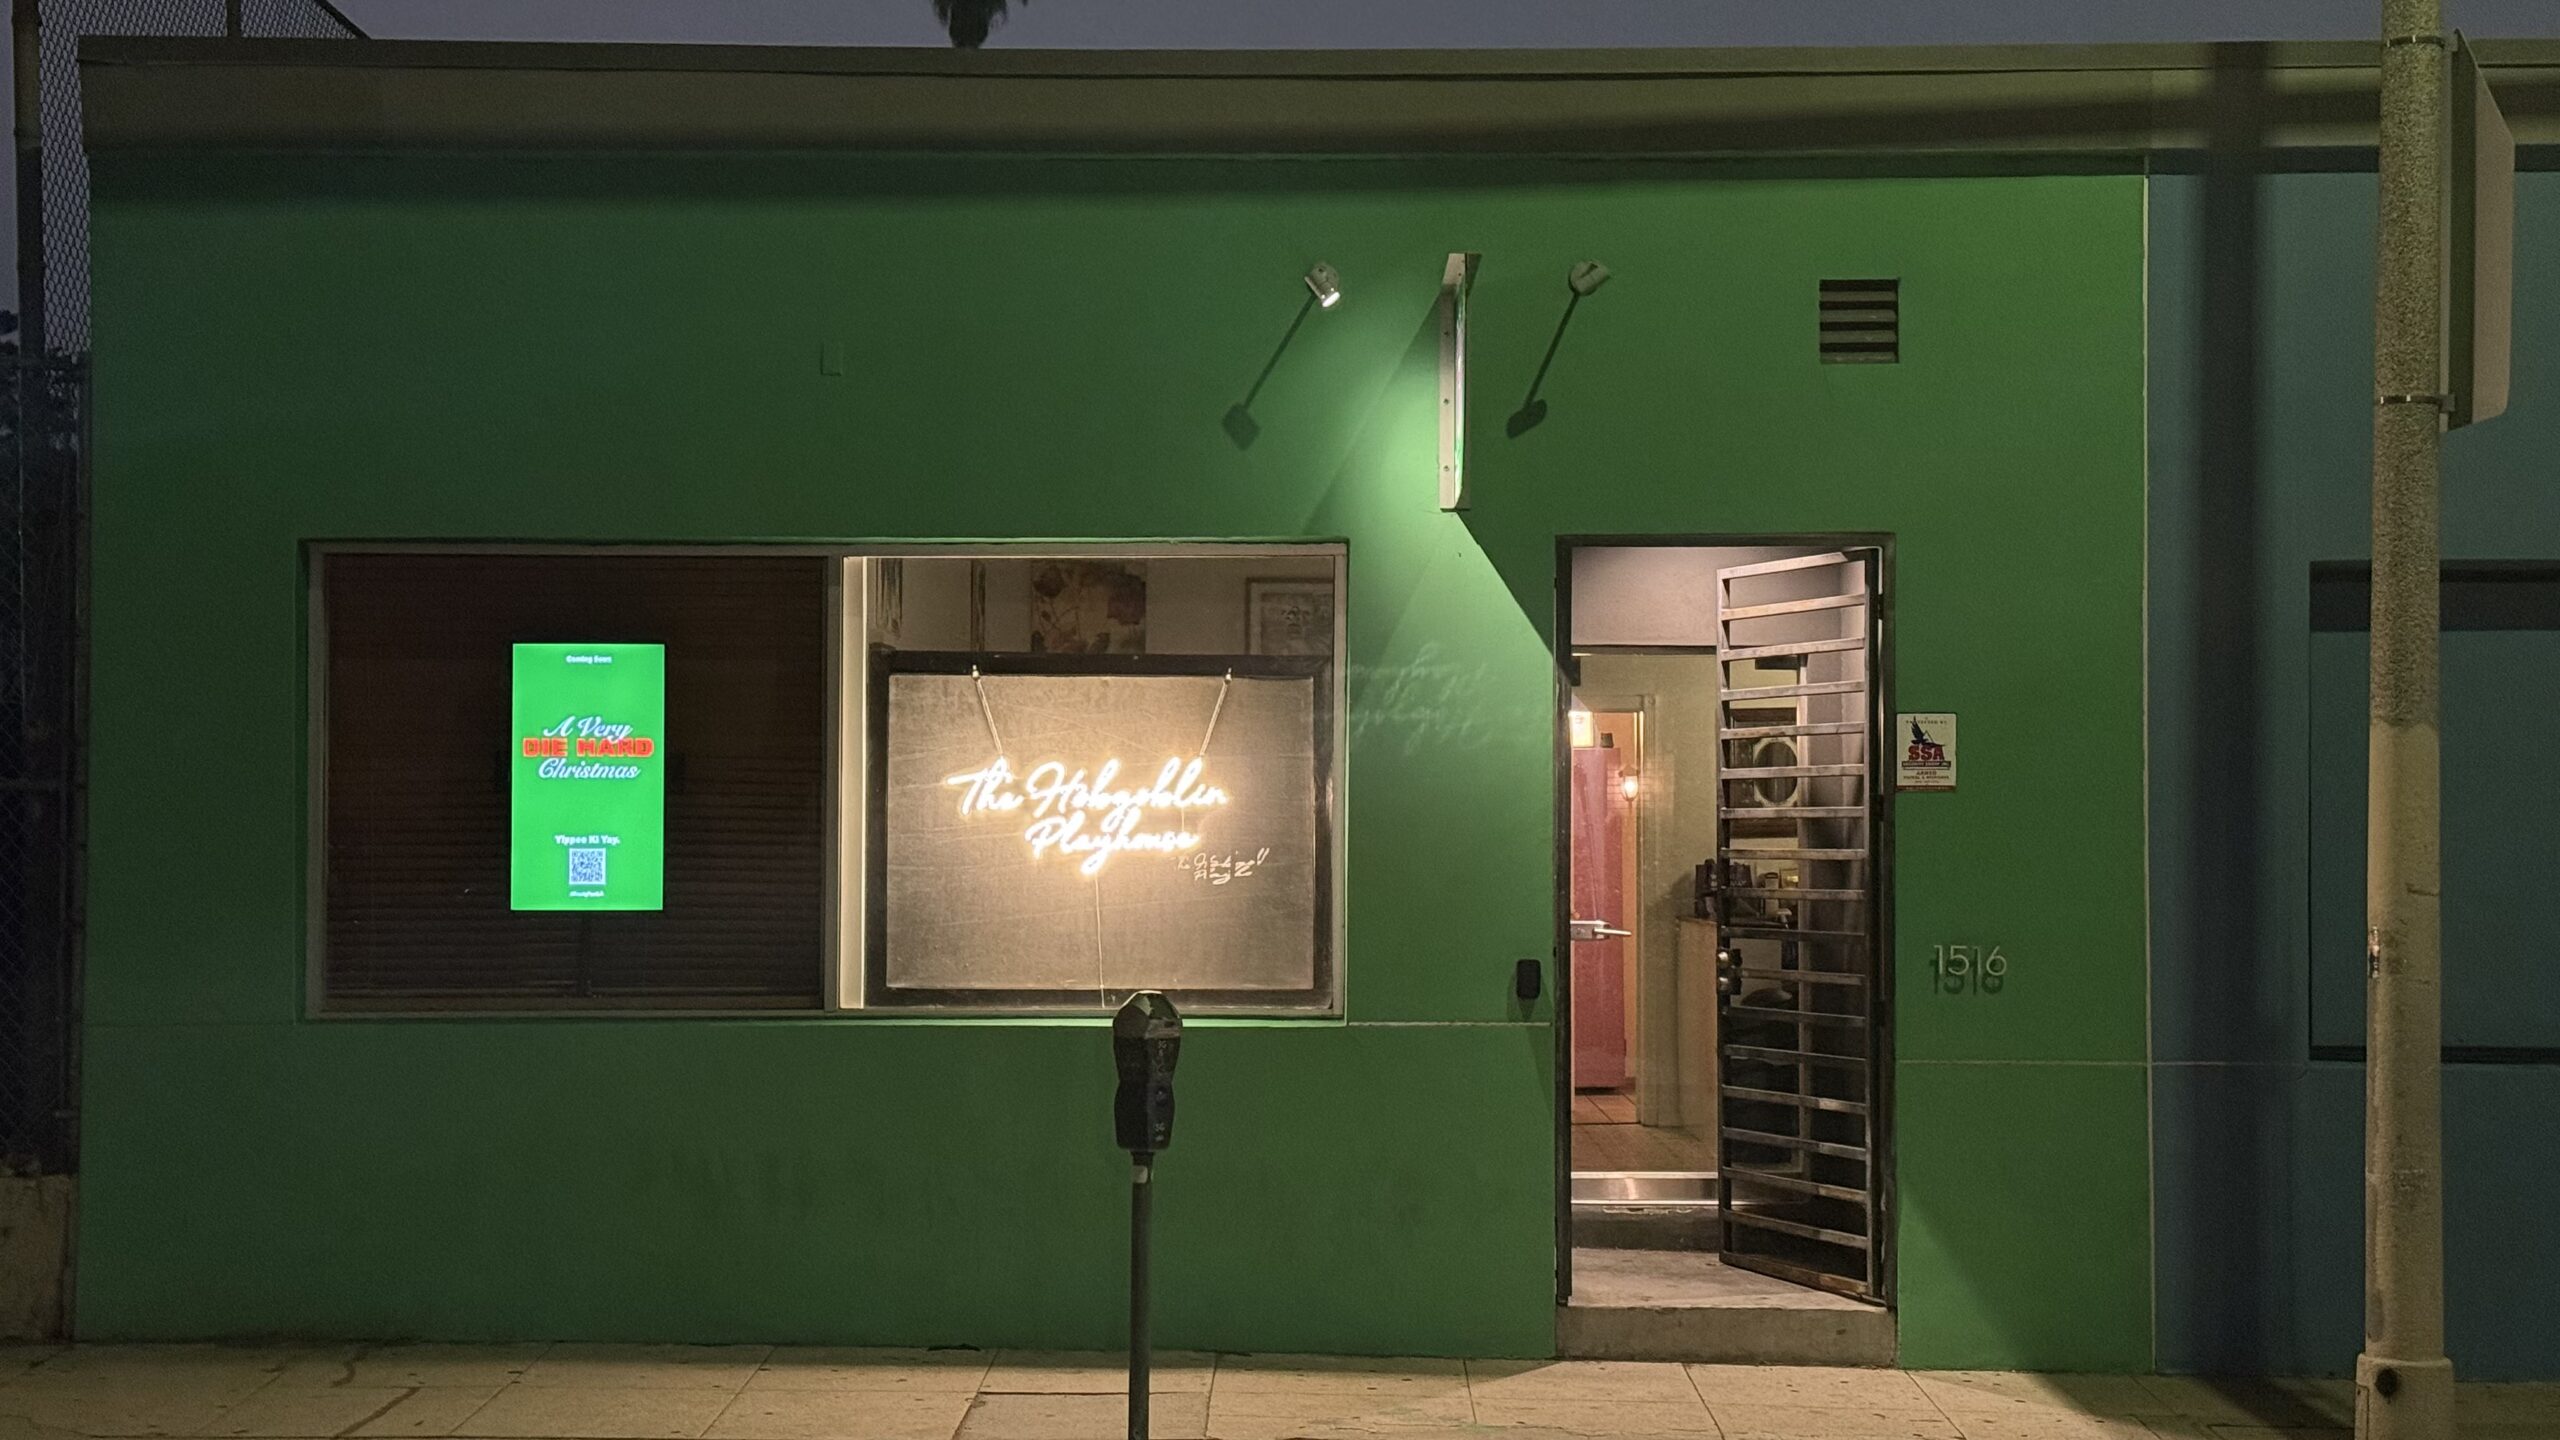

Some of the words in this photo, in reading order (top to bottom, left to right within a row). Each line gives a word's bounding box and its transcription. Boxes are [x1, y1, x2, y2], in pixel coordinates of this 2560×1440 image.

[543, 716, 576, 737] A
[577, 716, 633, 744] Very
[523, 737, 568, 757] DIE
[577, 737, 655, 757] HARD
[1908, 743, 1946, 761] SSA
[538, 757, 641, 779] Christmas
[947, 756, 1025, 816] The
[1025, 758, 1229, 833] Hobgoblin
[554, 834, 587, 846] Yippee
[1024, 808, 1200, 876] Playhouse
[1933, 944, 2007, 976] 1516
